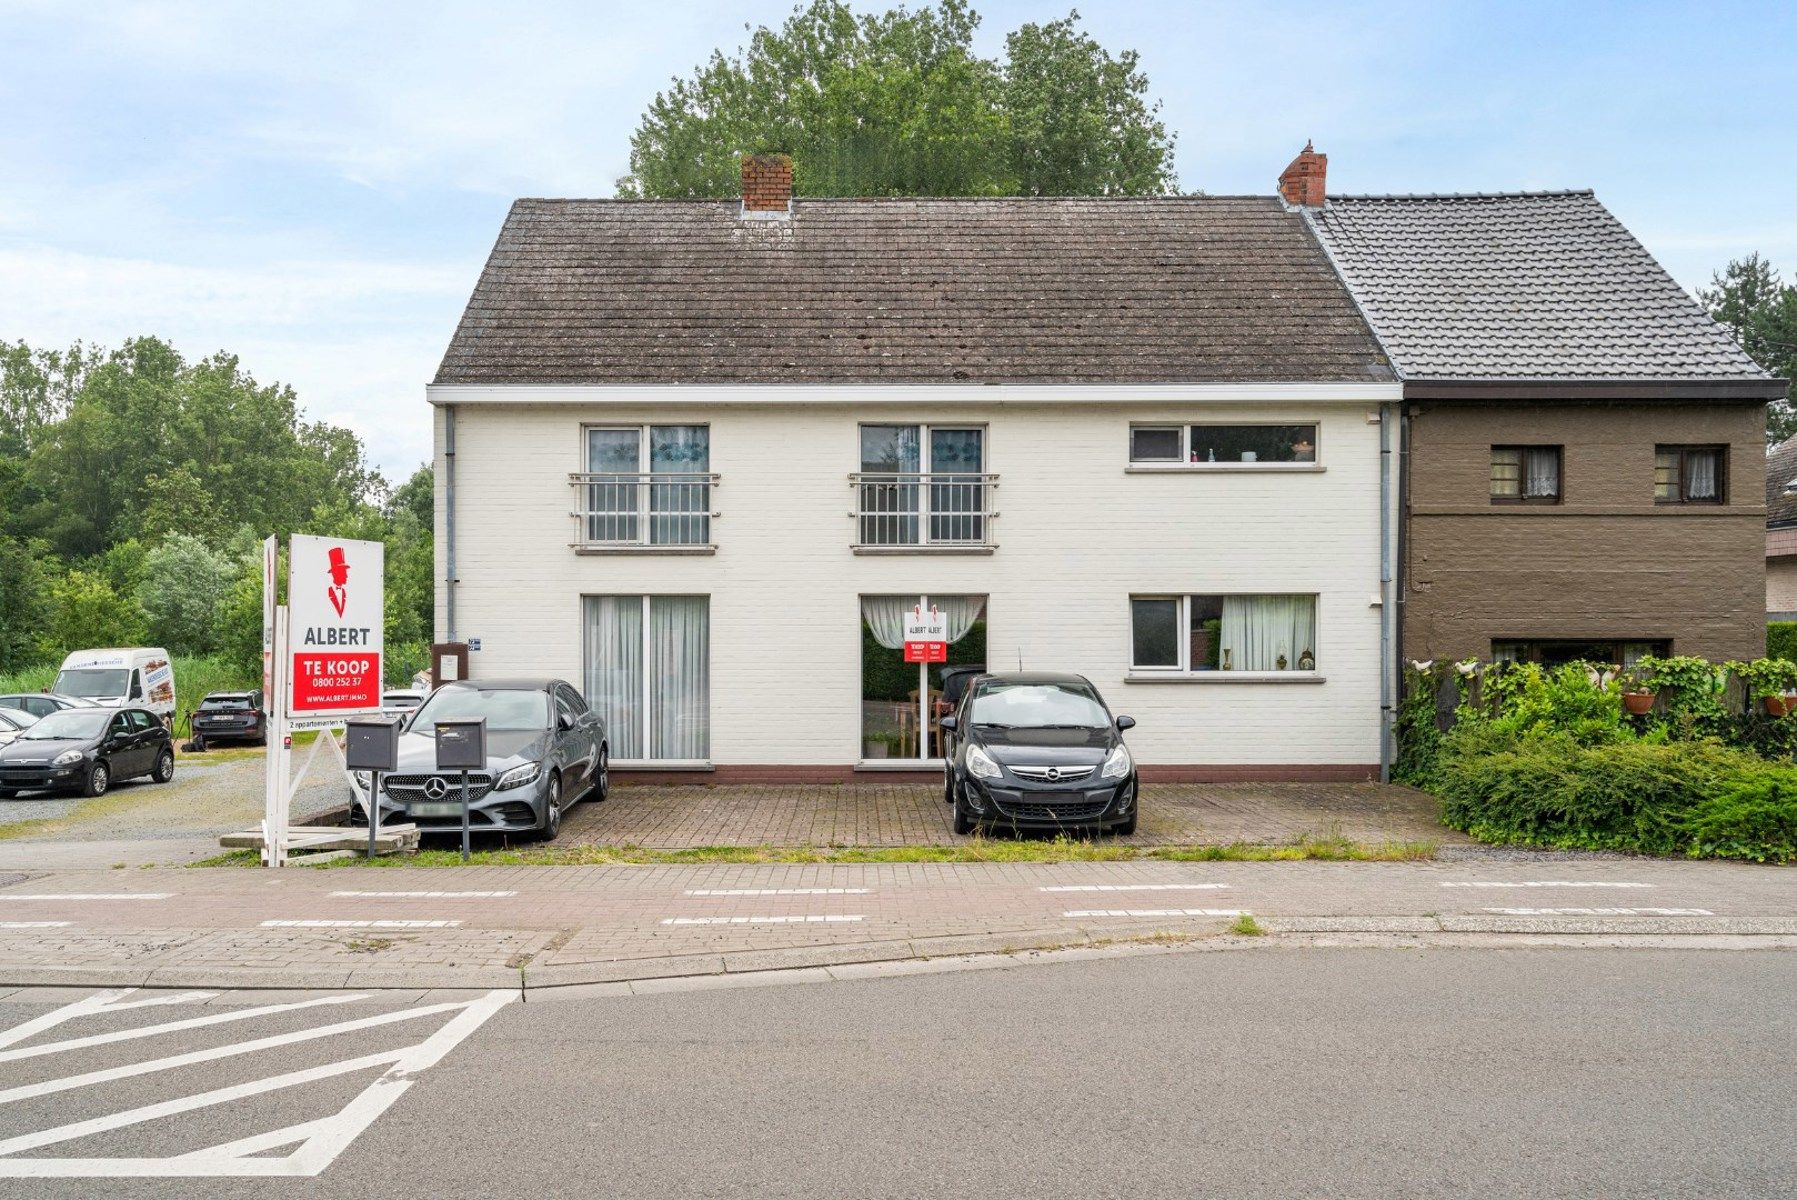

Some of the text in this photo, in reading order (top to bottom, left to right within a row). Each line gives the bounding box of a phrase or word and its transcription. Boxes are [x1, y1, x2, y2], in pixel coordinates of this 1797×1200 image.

[304, 627, 370, 646] ALBERT
[303, 660, 370, 676] TE KOOP
[312, 677, 362, 687] 0800 252 37
[306, 694, 367, 703] WWW.ALBERT.IMMO
